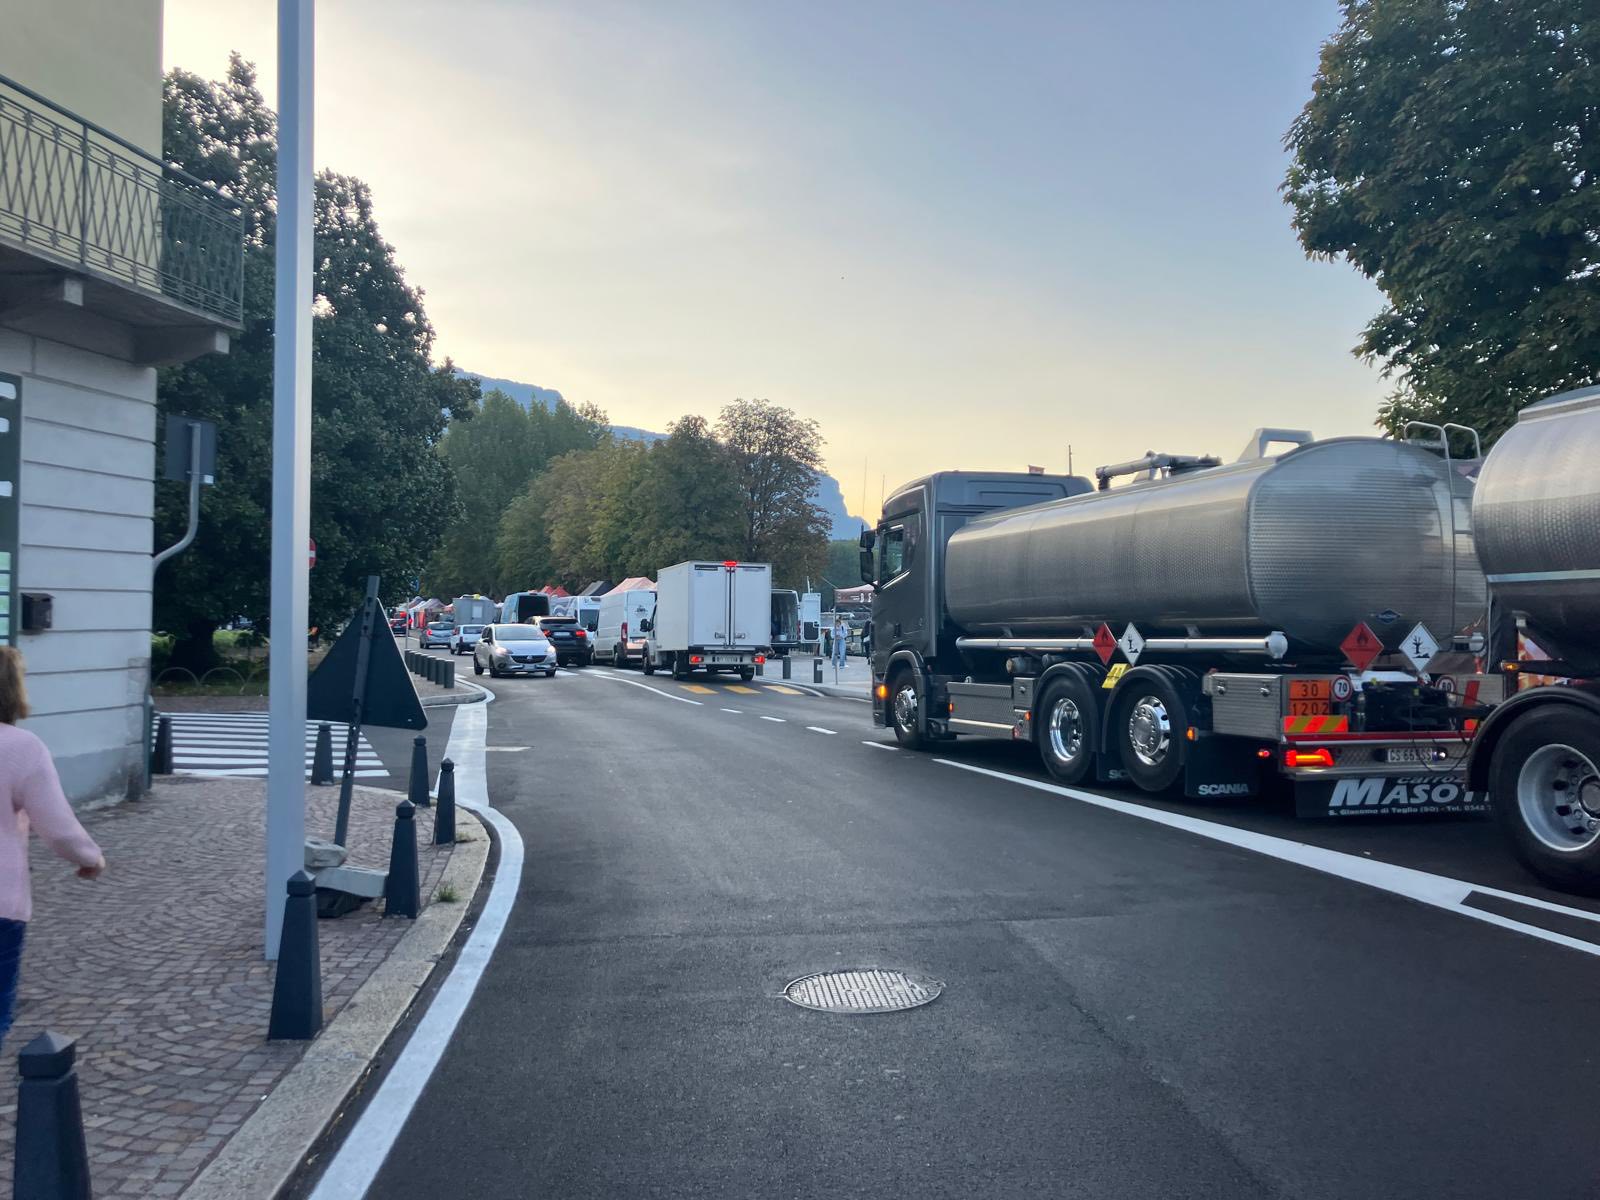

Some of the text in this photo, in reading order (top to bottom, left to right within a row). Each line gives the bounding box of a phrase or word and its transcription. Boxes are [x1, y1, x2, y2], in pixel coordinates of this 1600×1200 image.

[1302, 683, 1318, 697] 30
[1337, 682, 1348, 694] 70
[1292, 702, 1329, 716] 1202
[1198, 783, 1249, 795] SCANIA
[1392, 806, 1417, 815] Teglio
